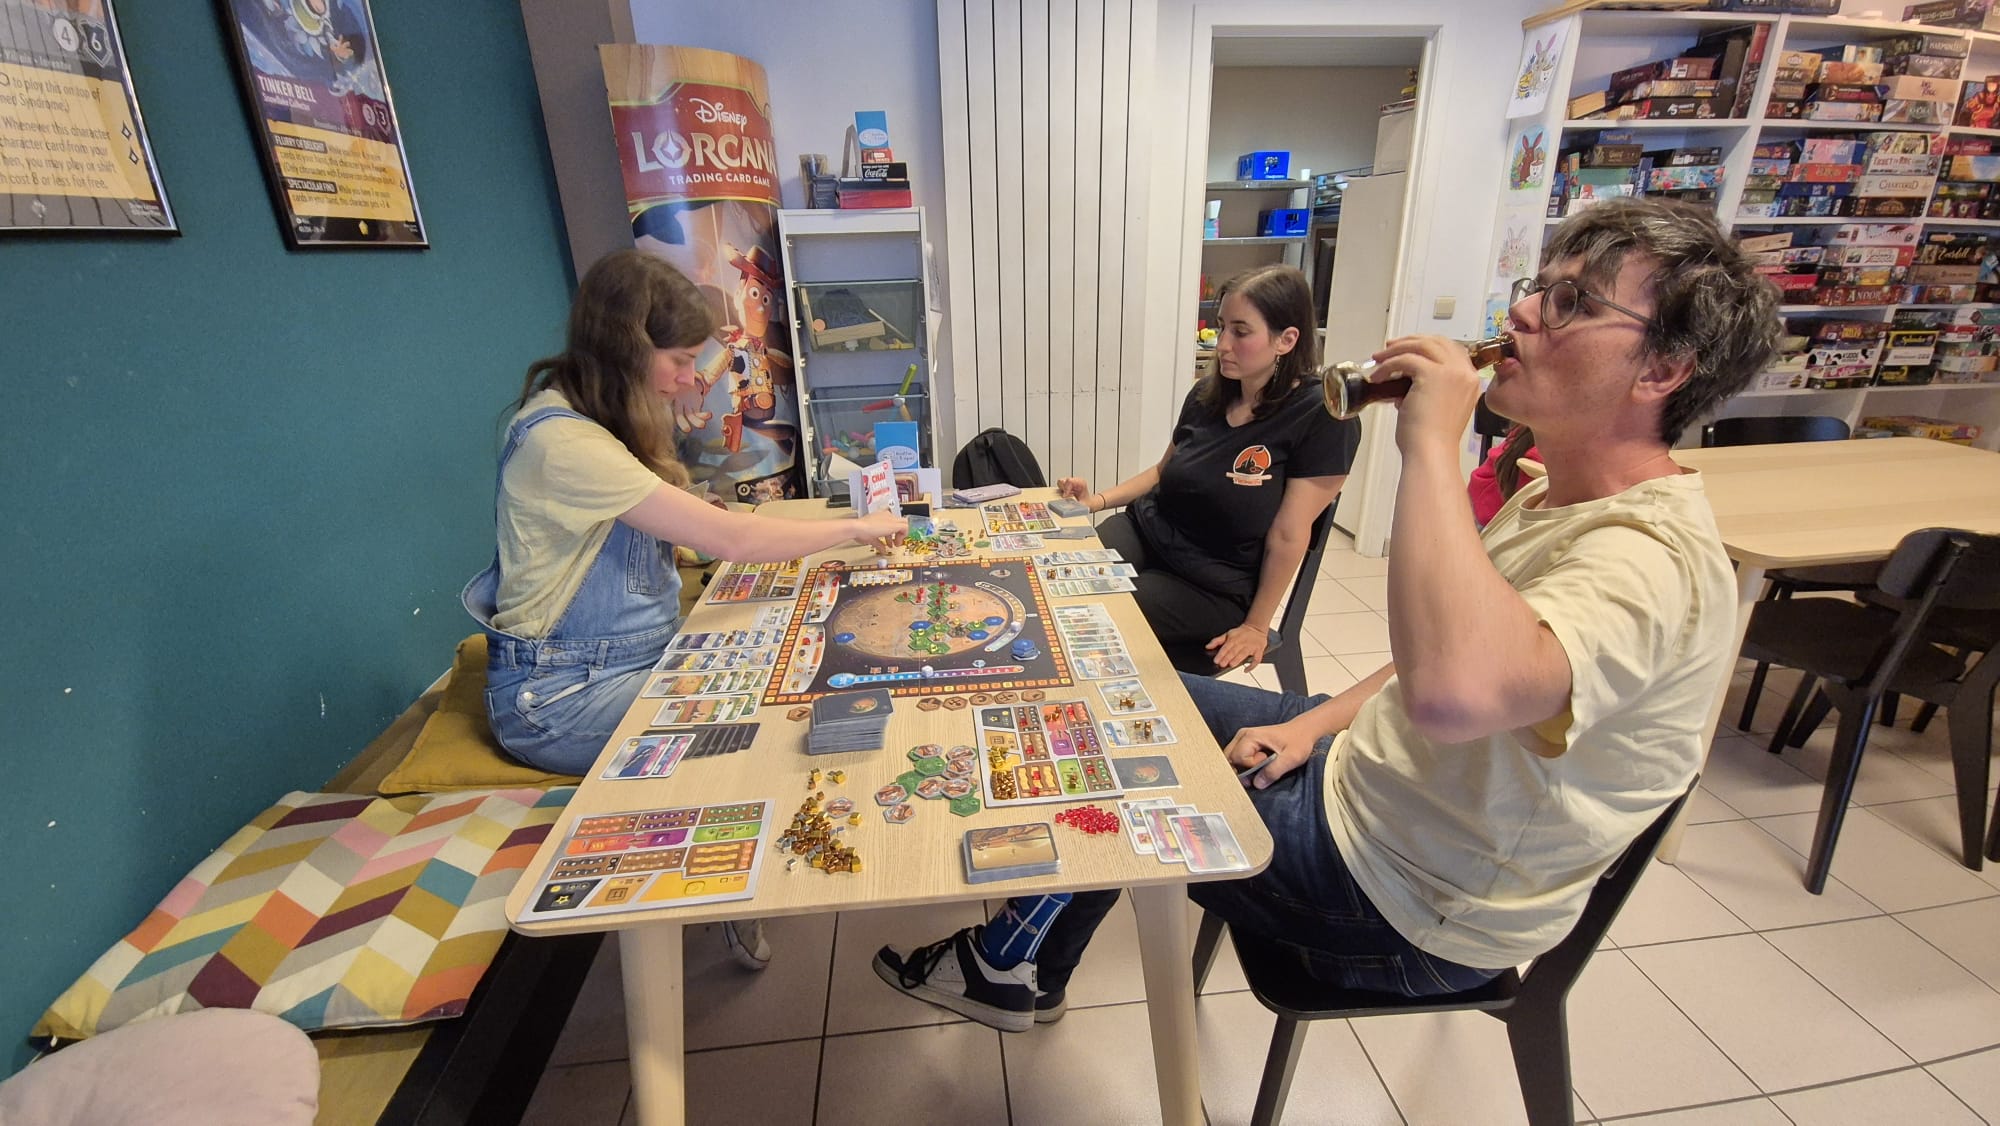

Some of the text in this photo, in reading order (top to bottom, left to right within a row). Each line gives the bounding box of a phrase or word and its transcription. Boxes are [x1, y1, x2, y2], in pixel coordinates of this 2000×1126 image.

[61, 26, 71, 45] 4
[92, 32, 102, 51] 6
[12, 77, 22, 88] to
[24, 79, 43, 94] play
[45, 79, 62, 94] this
[91, 88, 101, 104] of
[258, 75, 317, 103] TINKER BELL
[689, 98, 747, 132] Disney
[2, 115, 111, 141] Whenever this character
[45, 140, 66, 152] card
[67, 139, 88, 153] from
[90, 145, 108, 157] your
[631, 129, 778, 179] LORCANA
[26, 158, 43, 171] you
[45, 159, 64, 172] may
[66, 157, 84, 173] play
[86, 162, 95, 170] or
[10, 172, 108, 190] cost 8 or less for free.
[287, 178, 323, 191] SPECTACULAR
[669, 173, 723, 185] TRADING
[725, 173, 751, 184] CARD
[1846, 286, 1882, 302] ANDOR
